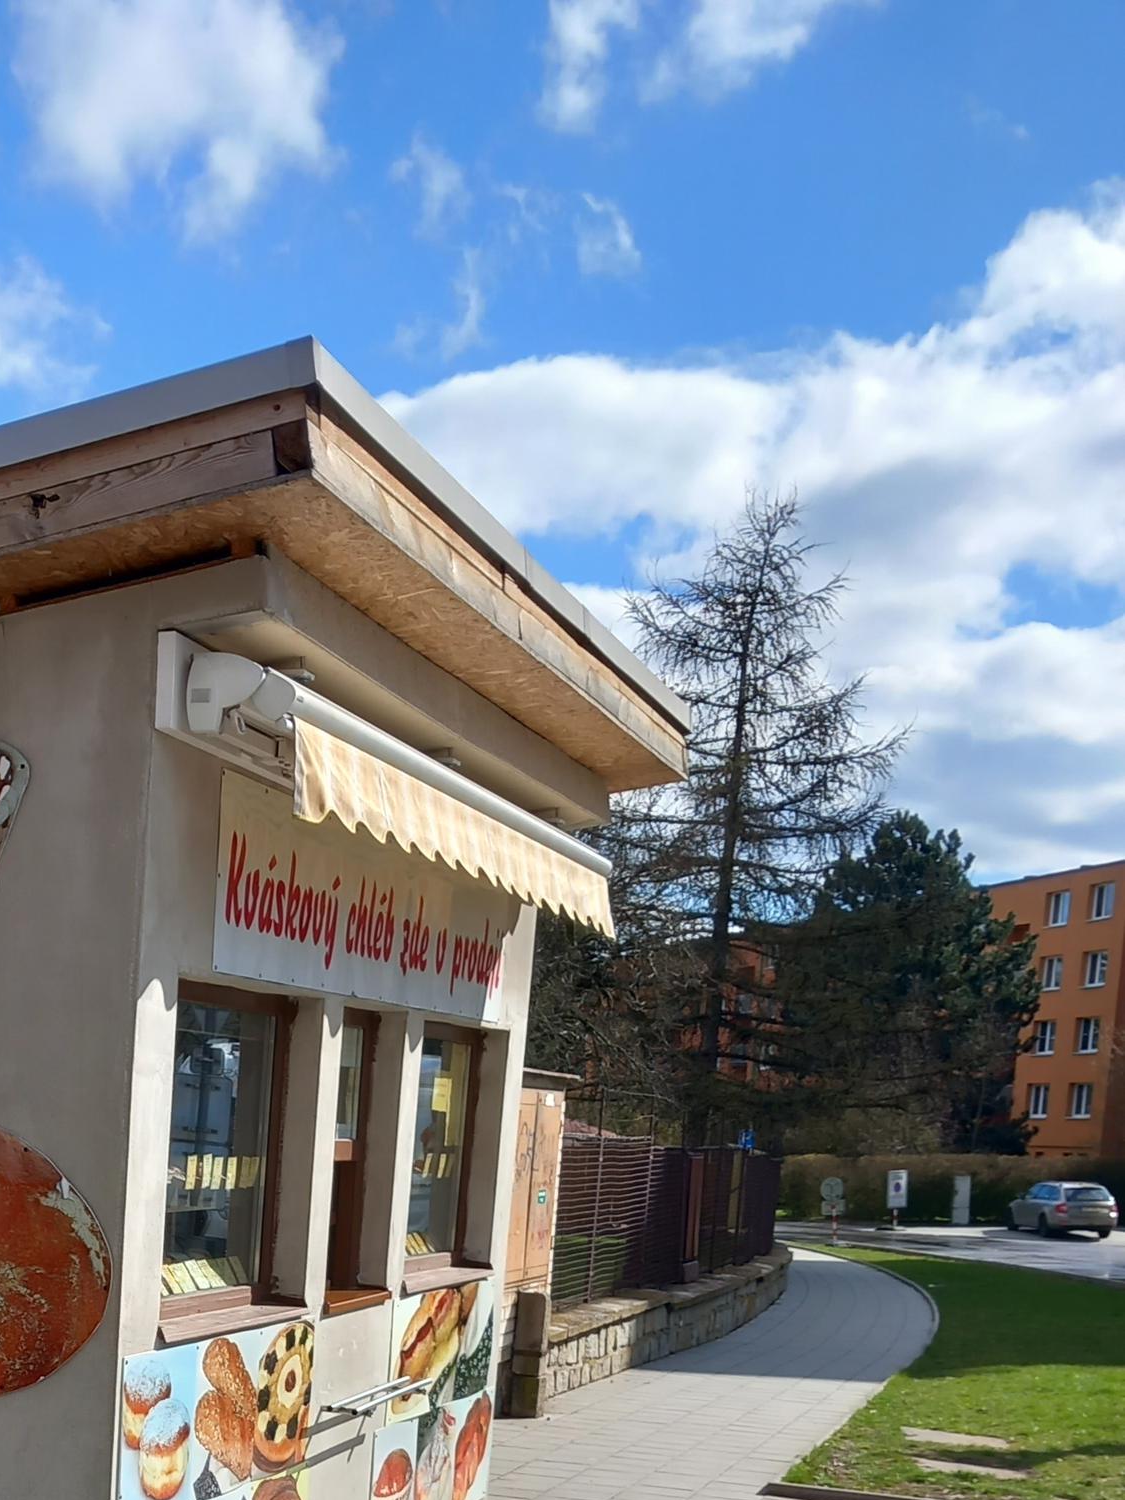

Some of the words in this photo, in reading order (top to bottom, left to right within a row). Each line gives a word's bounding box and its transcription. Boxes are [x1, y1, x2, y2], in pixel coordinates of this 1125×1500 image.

[225, 830, 341, 970] Kváskový
[345, 876, 394, 962] chléb
[399, 895, 429, 976] zde
[436, 928, 448, 975] v
